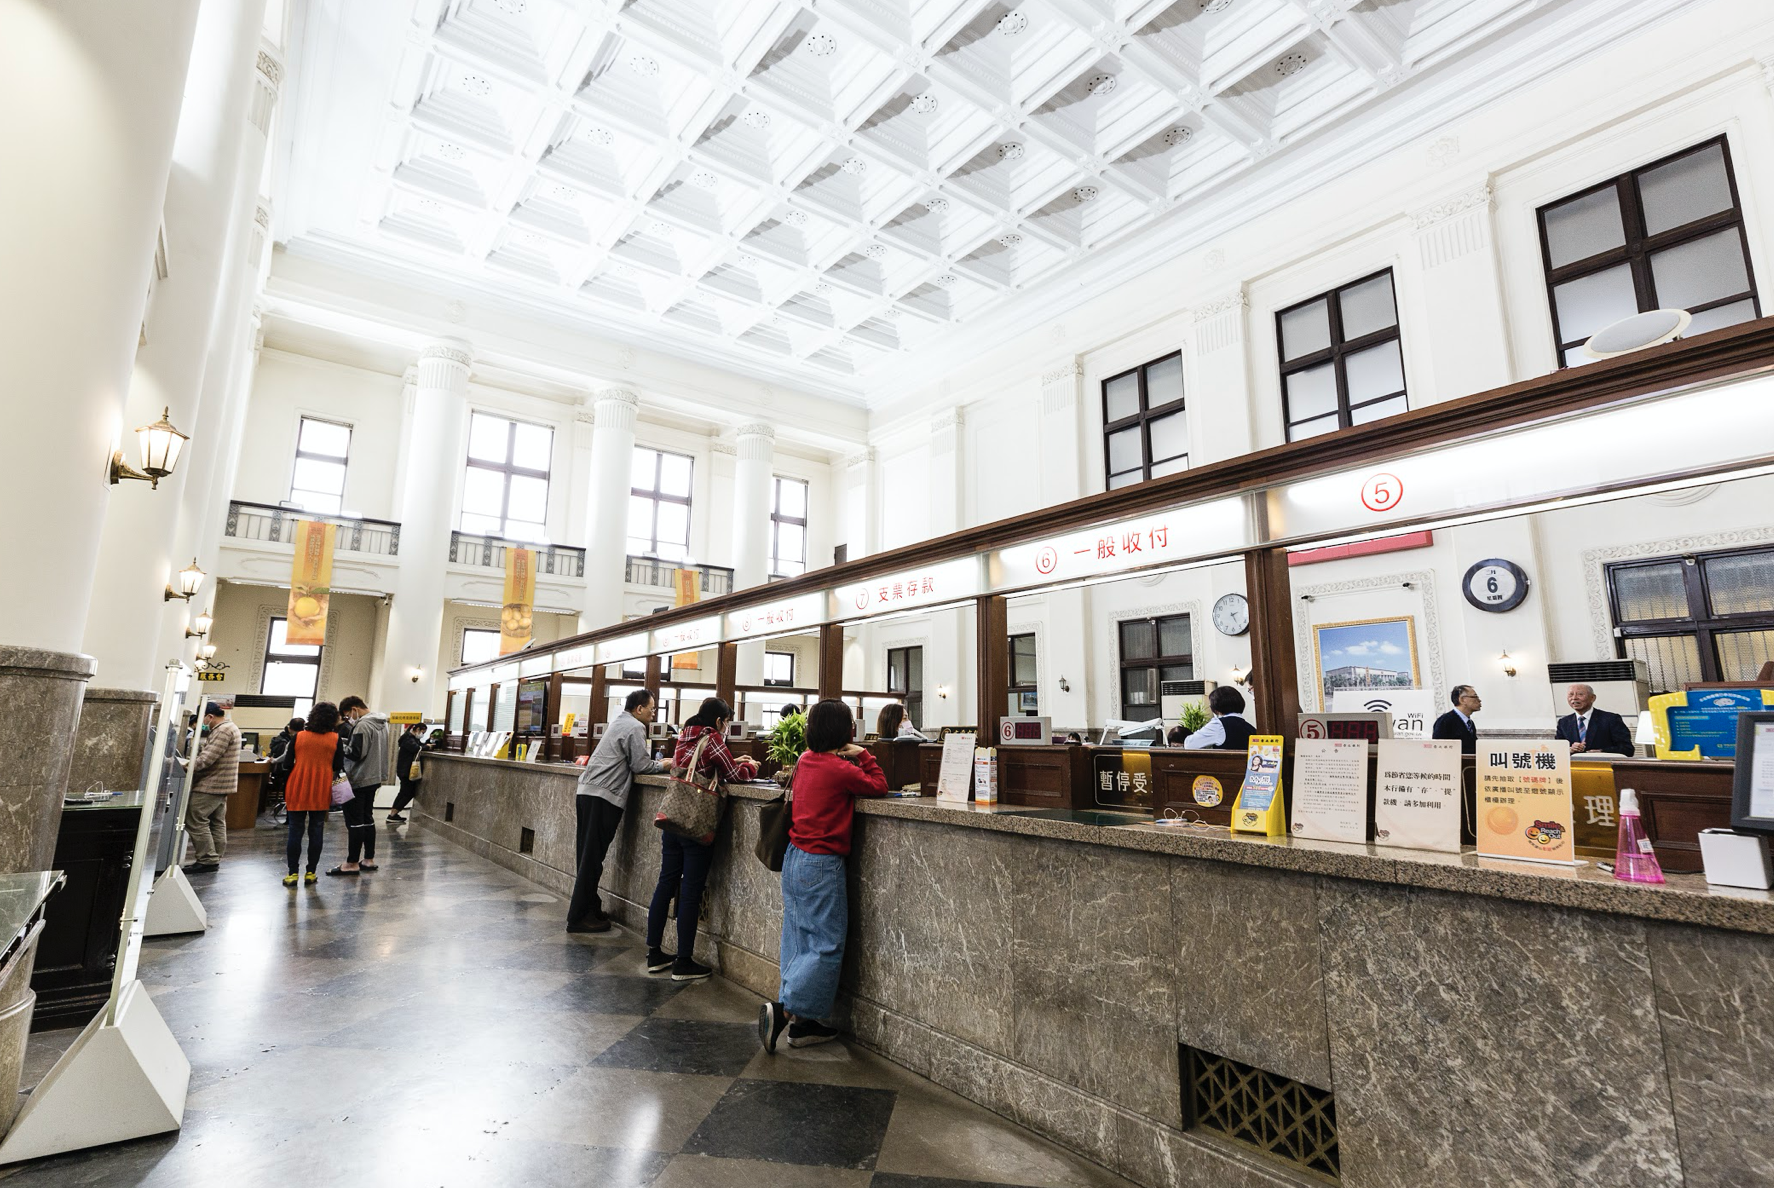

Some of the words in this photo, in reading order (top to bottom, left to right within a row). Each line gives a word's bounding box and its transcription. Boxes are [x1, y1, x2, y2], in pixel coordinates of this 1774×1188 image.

[1073, 524, 1168, 560] 一般收付
[878, 577, 934, 603] 支票存款
[1487, 576, 1498, 593] 6
[1489, 752, 1556, 770] 叫號機
[1099, 770, 1153, 794] 暫停受
[1534, 820, 1561, 830] Smile
[1540, 827, 1561, 836] Reach
